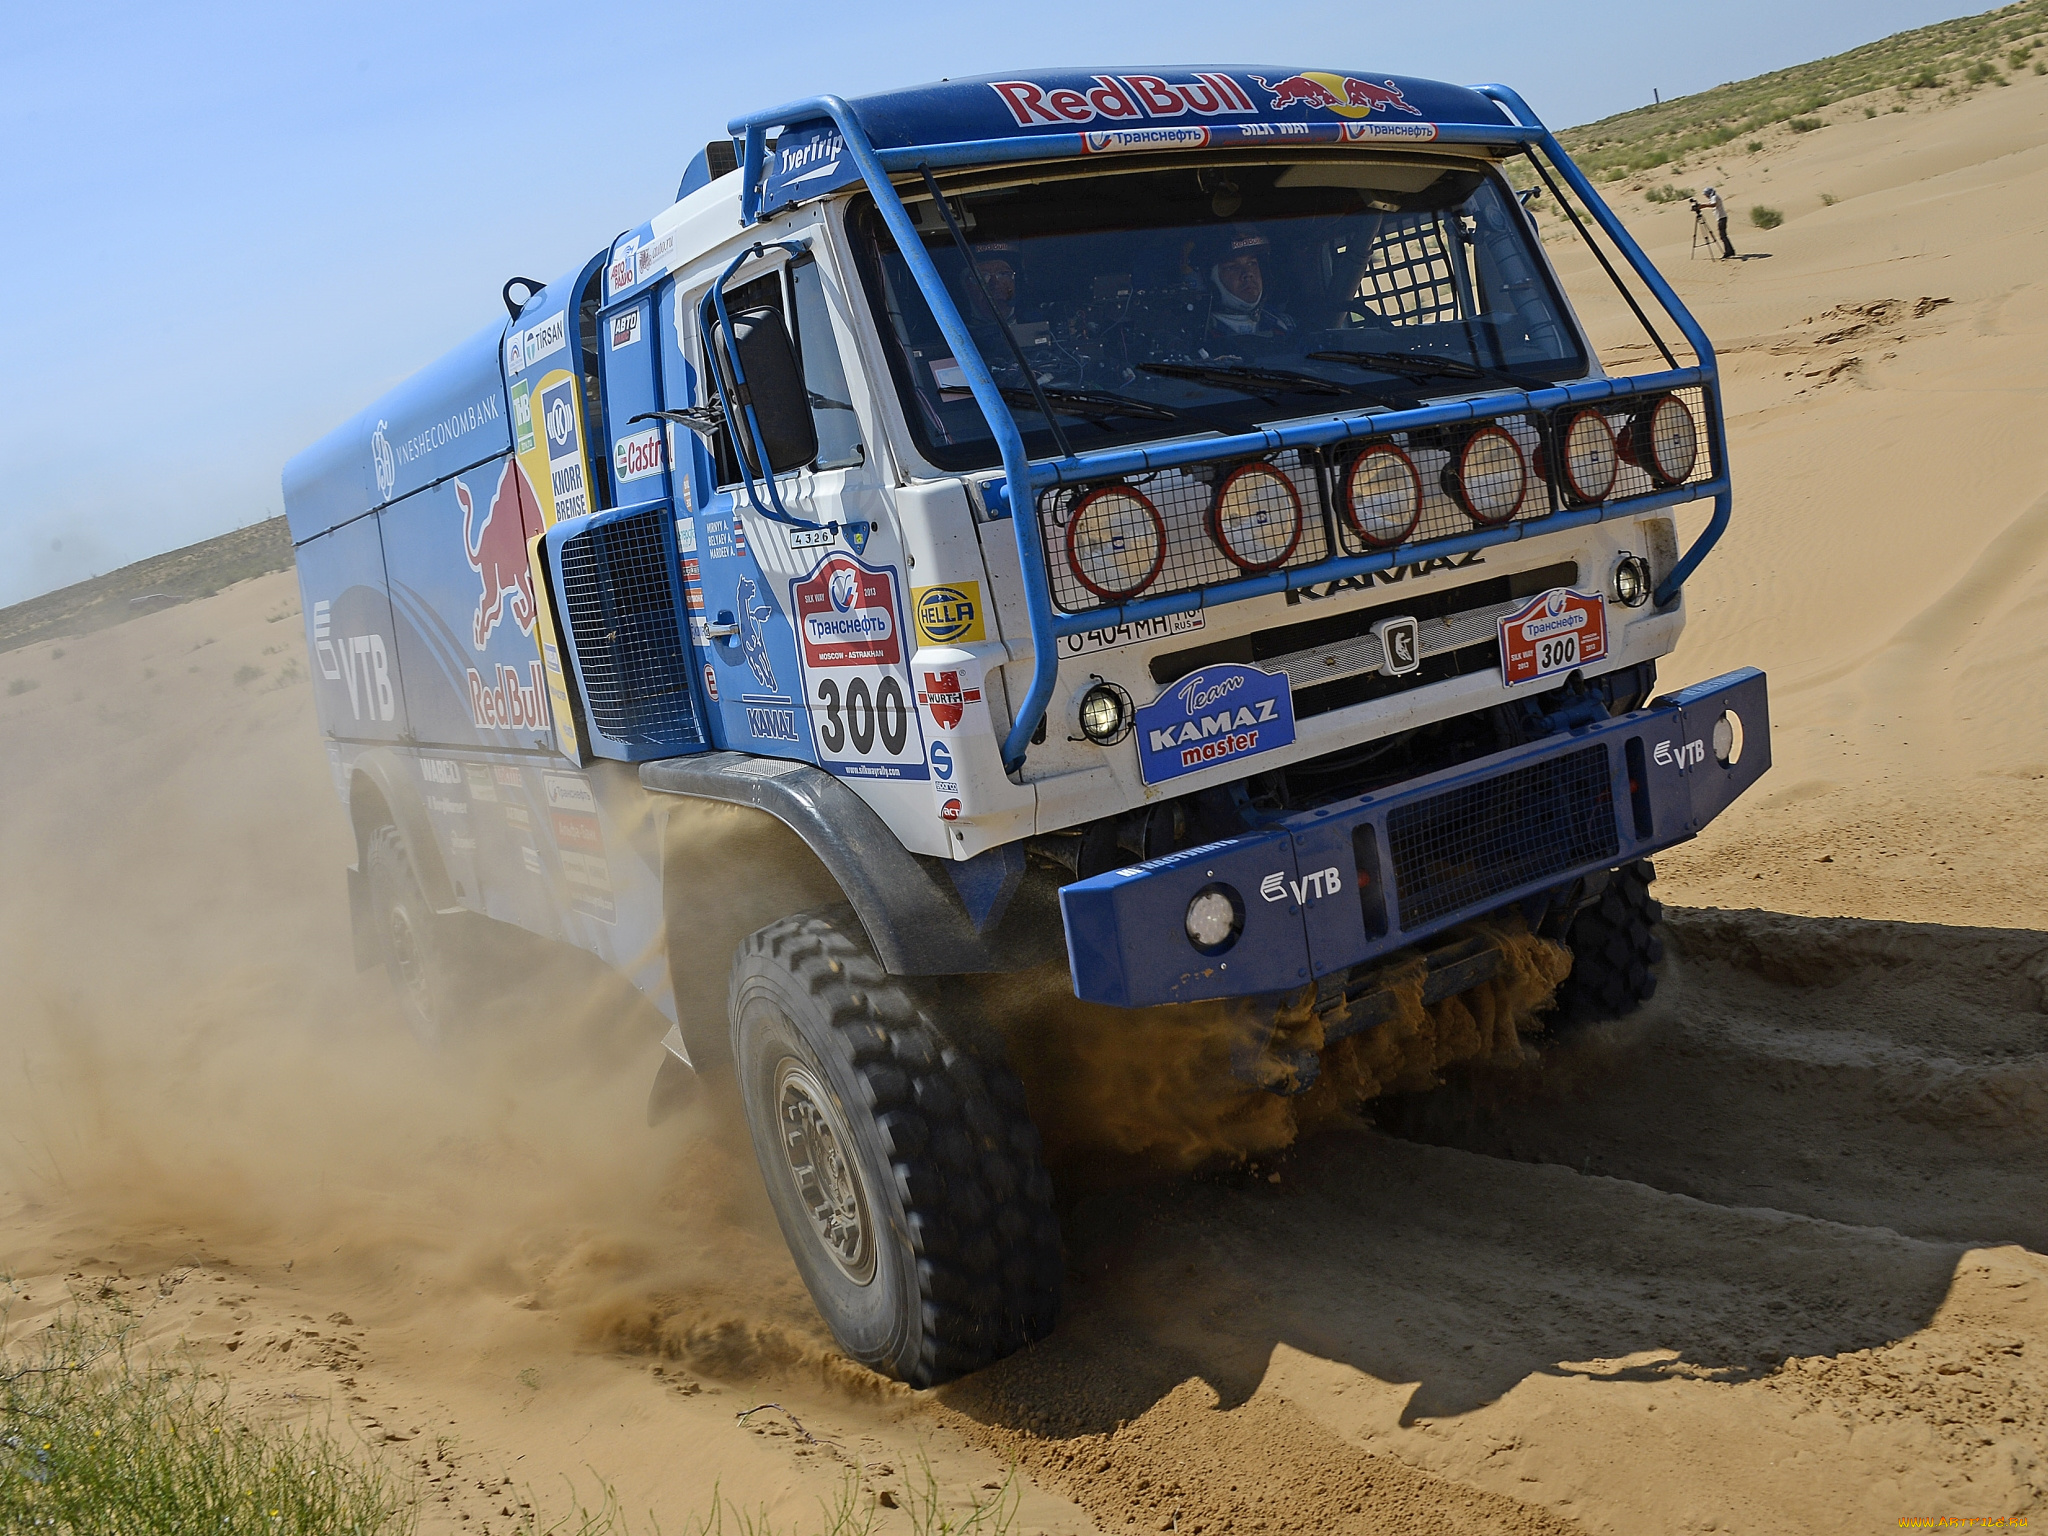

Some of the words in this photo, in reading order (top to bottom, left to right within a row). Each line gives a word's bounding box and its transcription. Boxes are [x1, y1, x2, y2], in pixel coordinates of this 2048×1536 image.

[988, 75, 1143, 127] Red
[1118, 73, 1258, 117] Bull
[1113, 130, 1202, 144] Транснефть
[1238, 124, 1274, 136] SILK
[1275, 123, 1309, 134] WAY
[1368, 124, 1432, 138] Транснефть
[396, 394, 499, 466] VNESHECONOMBANK
[628, 432, 673, 475] Castrl
[552, 464, 583, 496] KNORR
[556, 494, 586, 521] BREMSE
[864, 588, 876, 596] 2013
[809, 615, 886, 638] Транснефть
[921, 603, 974, 623] HELLA
[1175, 620, 1191, 630] RUS
[1527, 615, 1584, 636] Транснефть
[819, 652, 844, 660] MOSCOW
[849, 650, 884, 658] ASTRAKHAN
[1542, 637, 1575, 668] 300
[338, 634, 395, 721] VTB
[467, 663, 510, 729] Red
[504, 660, 550, 730] Bull
[1179, 675, 1244, 715] Team
[746, 707, 800, 741] KAMAZ
[818, 676, 907, 755] 300
[1150, 699, 1278, 752] KAMAZ
[1181, 730, 1259, 767] master
[1673, 739, 1705, 769] VTB
[420, 758, 462, 784] WABCO
[845, 765, 900, 778] www.silkwayrally.com
[1289, 866, 1342, 905] VTB
